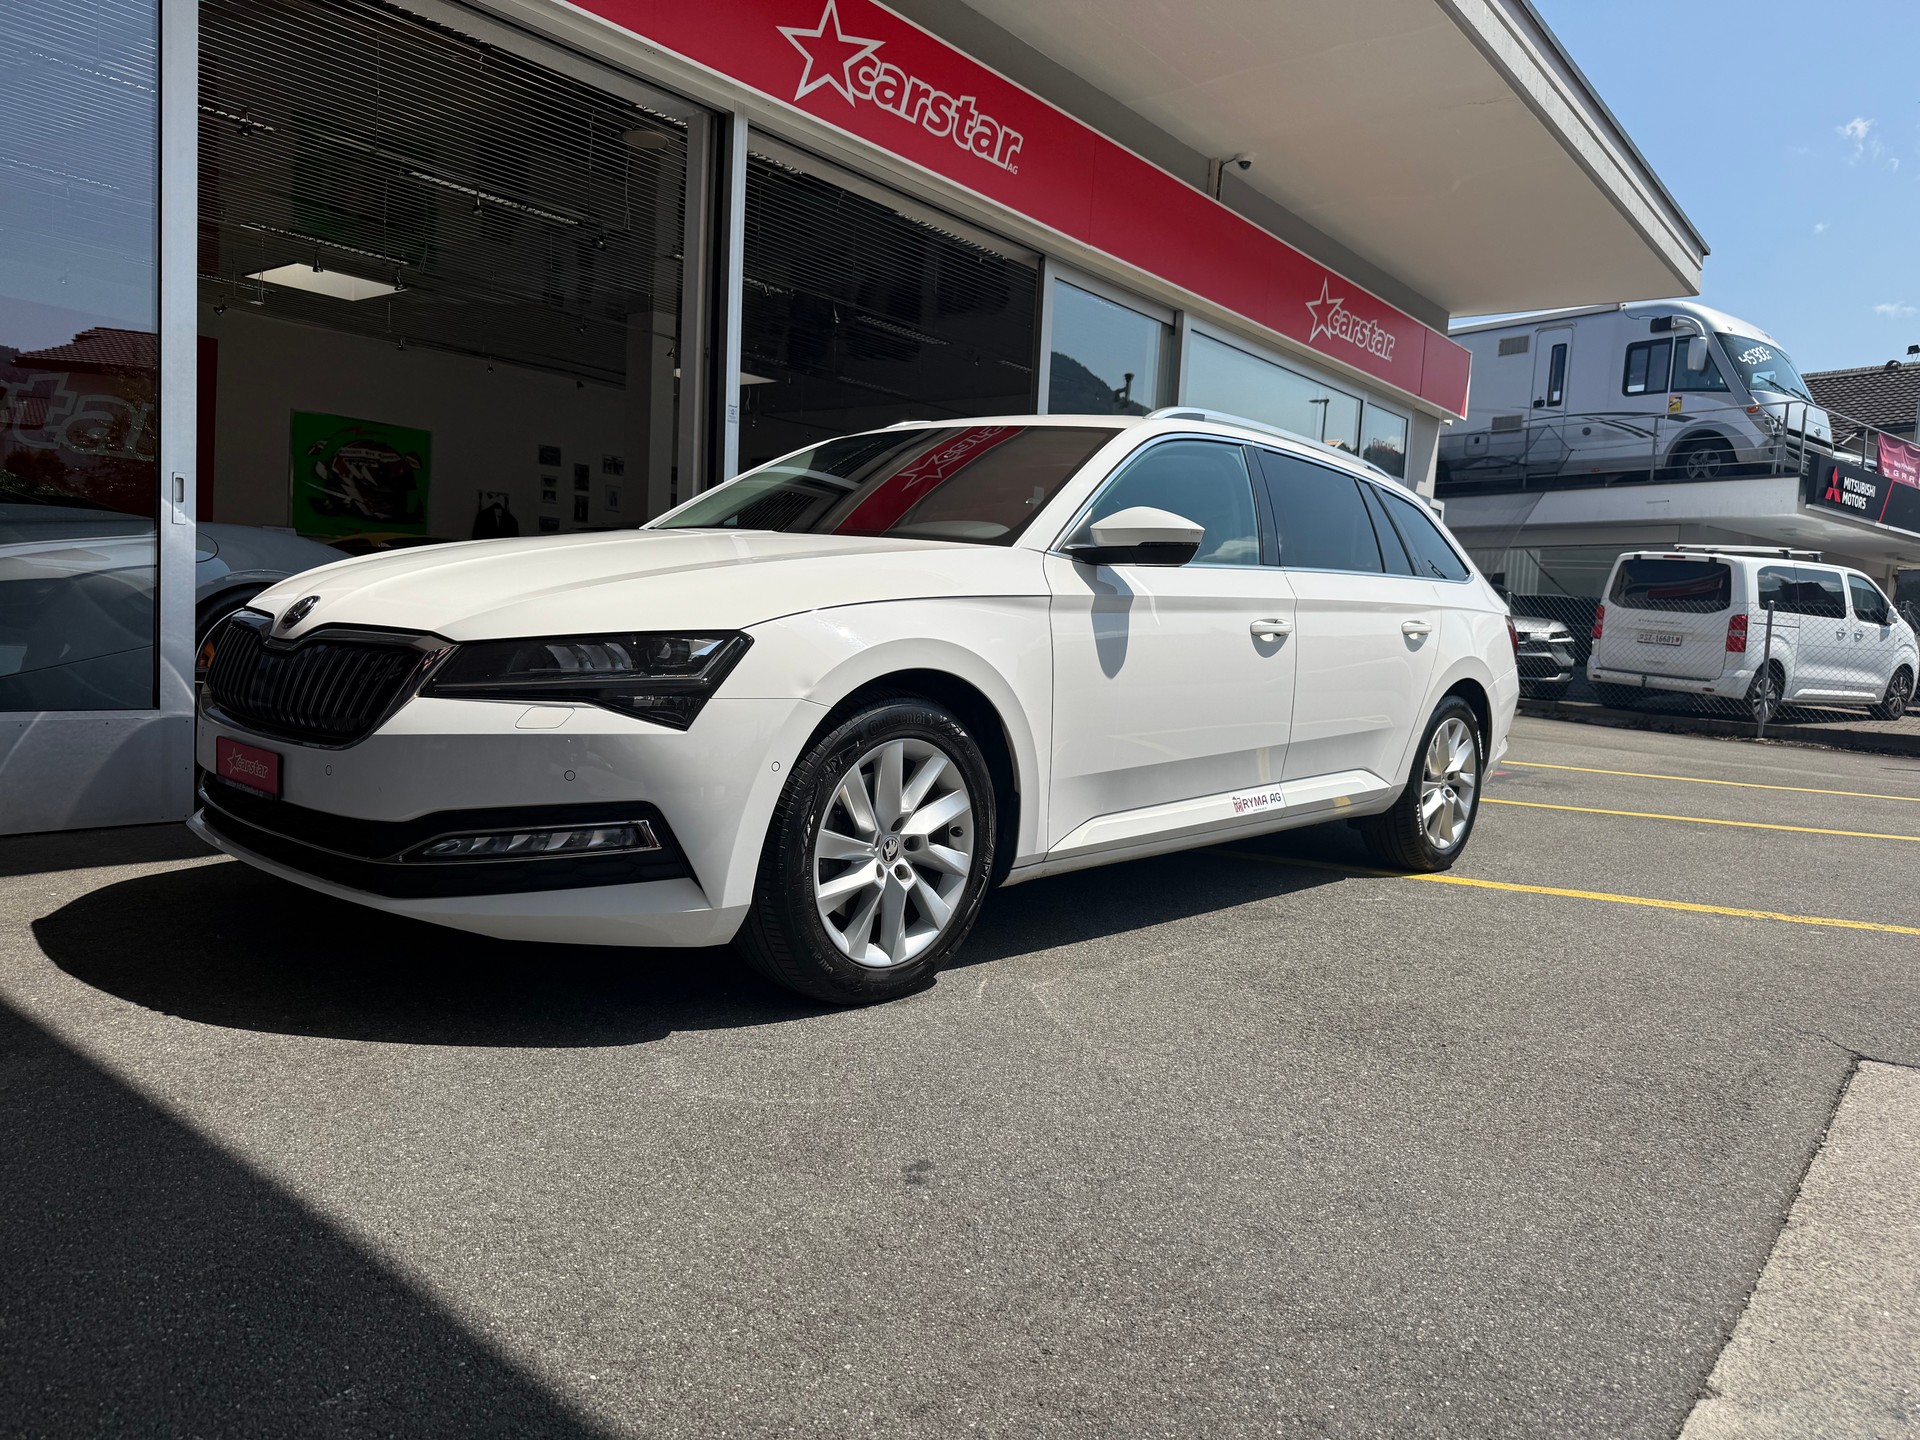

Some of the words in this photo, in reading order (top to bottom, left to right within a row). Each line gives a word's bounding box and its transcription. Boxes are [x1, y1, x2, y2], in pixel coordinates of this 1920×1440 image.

[848, 52, 1024, 169] carstar
[1007, 165, 1018, 175] AG
[1328, 306, 1396, 360] carstar
[1843, 476, 1876, 498] MITSUBISHI
[1841, 491, 1867, 510] MOTORS
[236, 758, 268, 778] carstar
[1242, 795, 1268, 808] RYMA
[1270, 792, 1281, 803] AG
